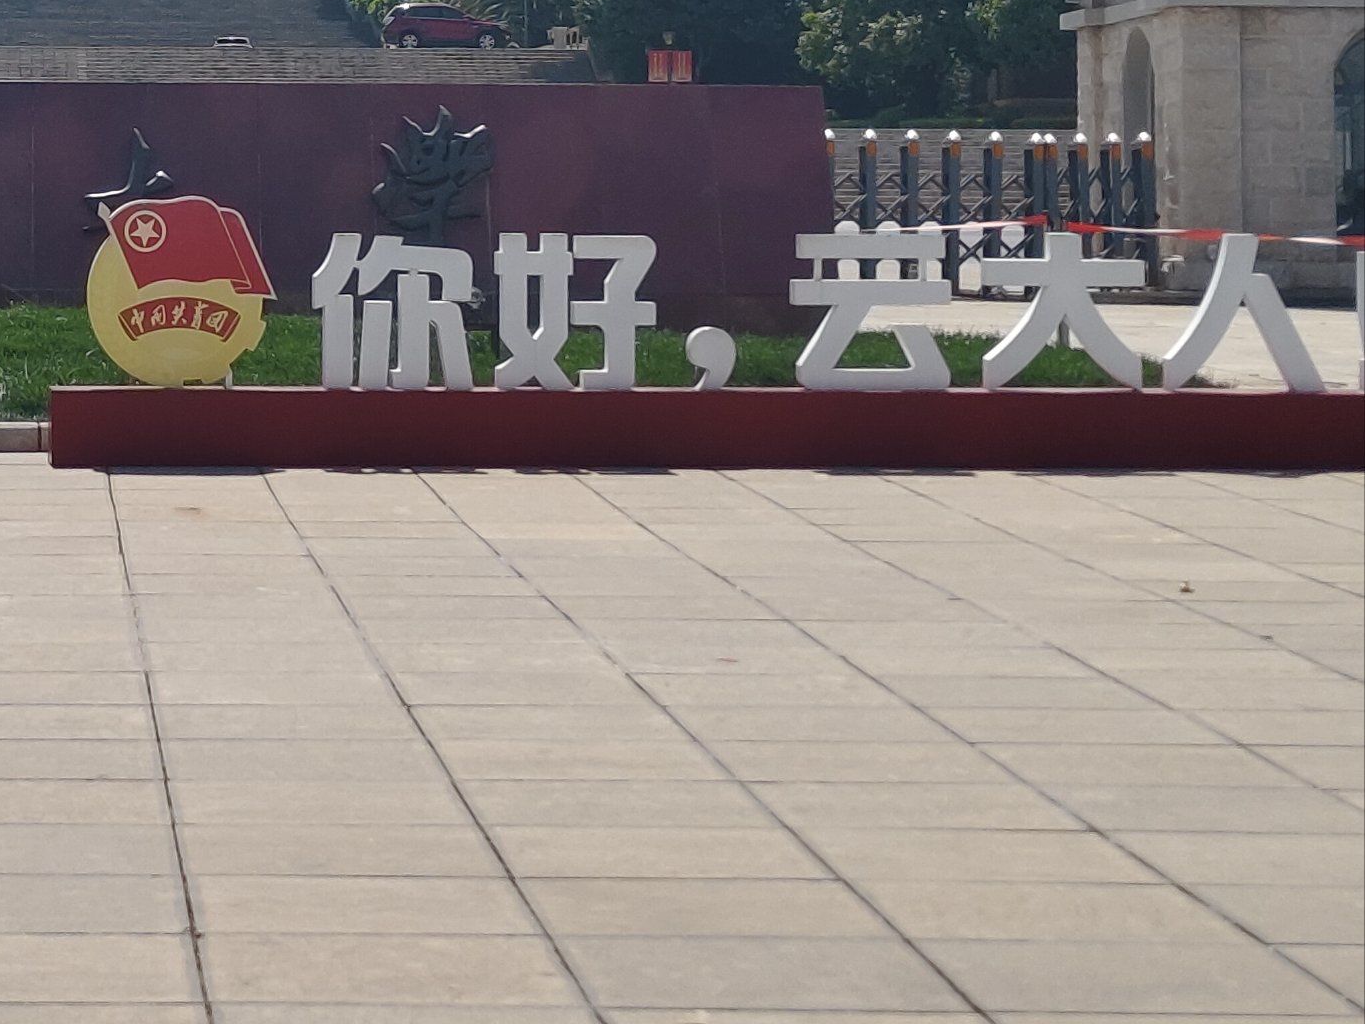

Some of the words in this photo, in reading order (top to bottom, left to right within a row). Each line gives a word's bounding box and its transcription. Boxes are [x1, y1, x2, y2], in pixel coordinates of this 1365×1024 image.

[312, 232, 1365, 393] 你好，云大人
